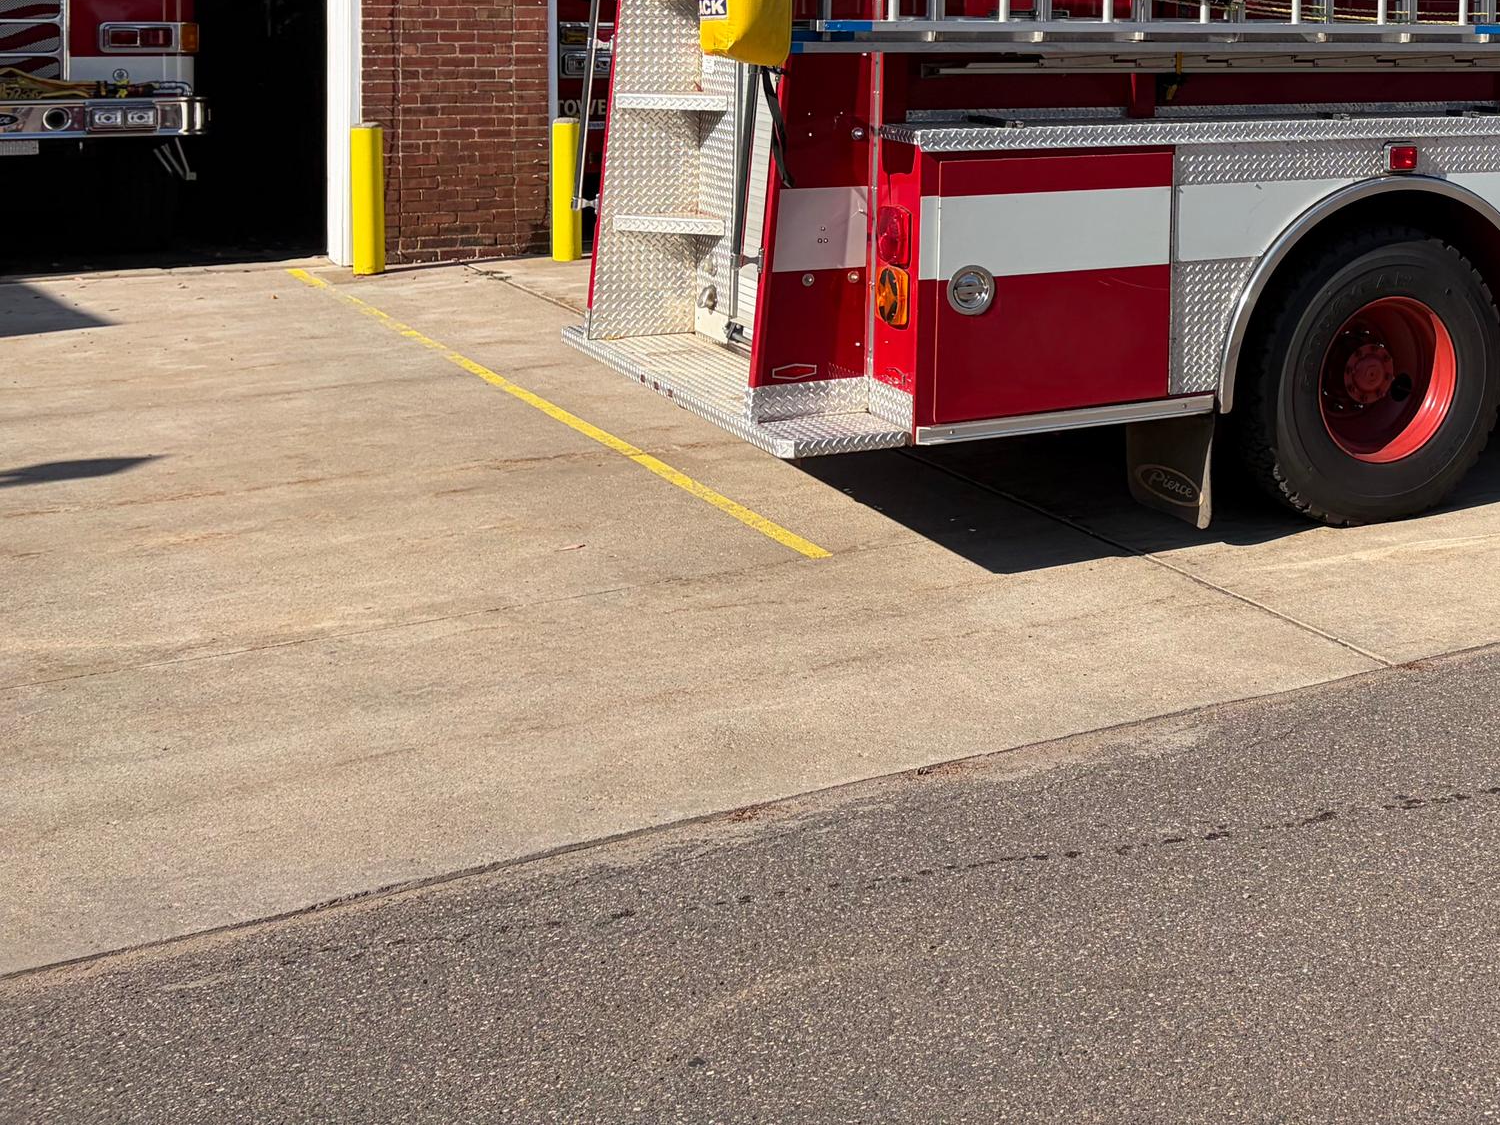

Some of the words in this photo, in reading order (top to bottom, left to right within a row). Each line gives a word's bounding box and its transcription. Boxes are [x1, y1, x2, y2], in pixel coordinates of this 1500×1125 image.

[698, 0, 726, 15] ACK
[558, 98, 607, 116] TOWE
[1148, 469, 1193, 498] Pierce
